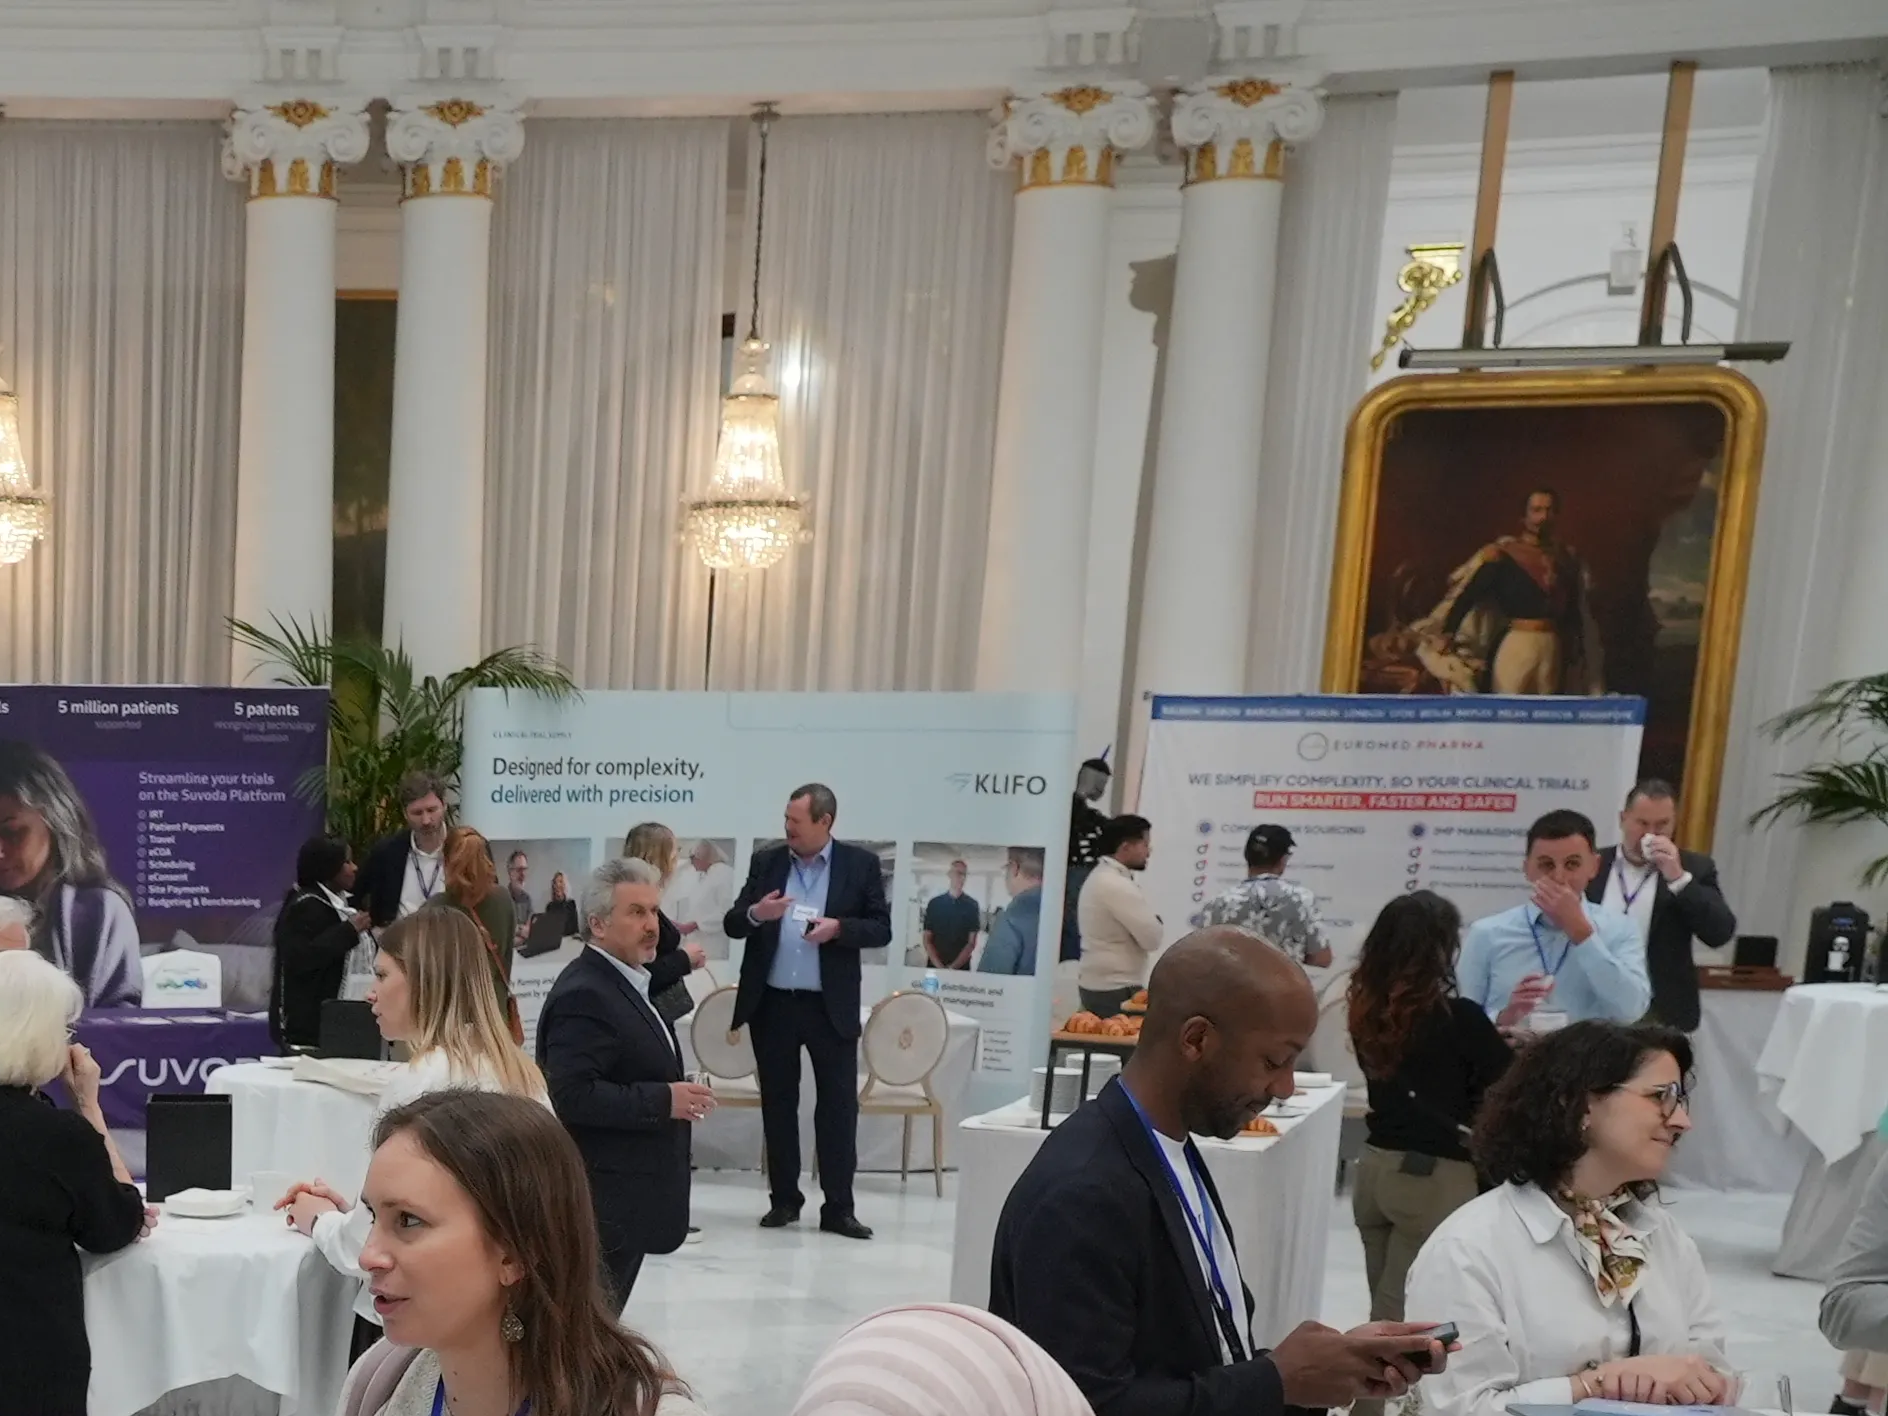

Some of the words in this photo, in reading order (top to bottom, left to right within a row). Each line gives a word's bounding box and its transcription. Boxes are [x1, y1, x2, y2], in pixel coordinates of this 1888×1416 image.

[58, 700, 68, 713] 5
[70, 699, 118, 714] million
[121, 700, 180, 716] patients
[234, 702, 244, 716] 5
[246, 703, 300, 718] patents
[493, 757, 562, 781] Designed
[567, 757, 590, 775] for
[596, 757, 704, 781] complexity,
[138, 771, 209, 785] Streamline
[210, 774, 238, 787] your
[242, 772, 275, 785] trials
[975, 774, 1047, 795] KLIFO
[1189, 774, 1211, 786] WE
[1215, 774, 1282, 786] SIMPLIFY
[1392, 776, 1413, 788] SO
[1417, 776, 1461, 788] YOUR
[1463, 777, 1533, 789] CLINICAL
[1537, 777, 1590, 790] TRIALS
[138, 790, 154, 801] on
[157, 788, 179, 801] the
[181, 788, 228, 801] Suvoda
[229, 788, 286, 801] Platform
[491, 784, 561, 803] delivered
[566, 784, 603, 803] with
[609, 784, 694, 807] precision
[1255, 794, 1289, 807] RUN
[1369, 796, 1425, 809] FASTER
[1429, 797, 1462, 809] AND
[1463, 797, 1514, 810] SAFER
